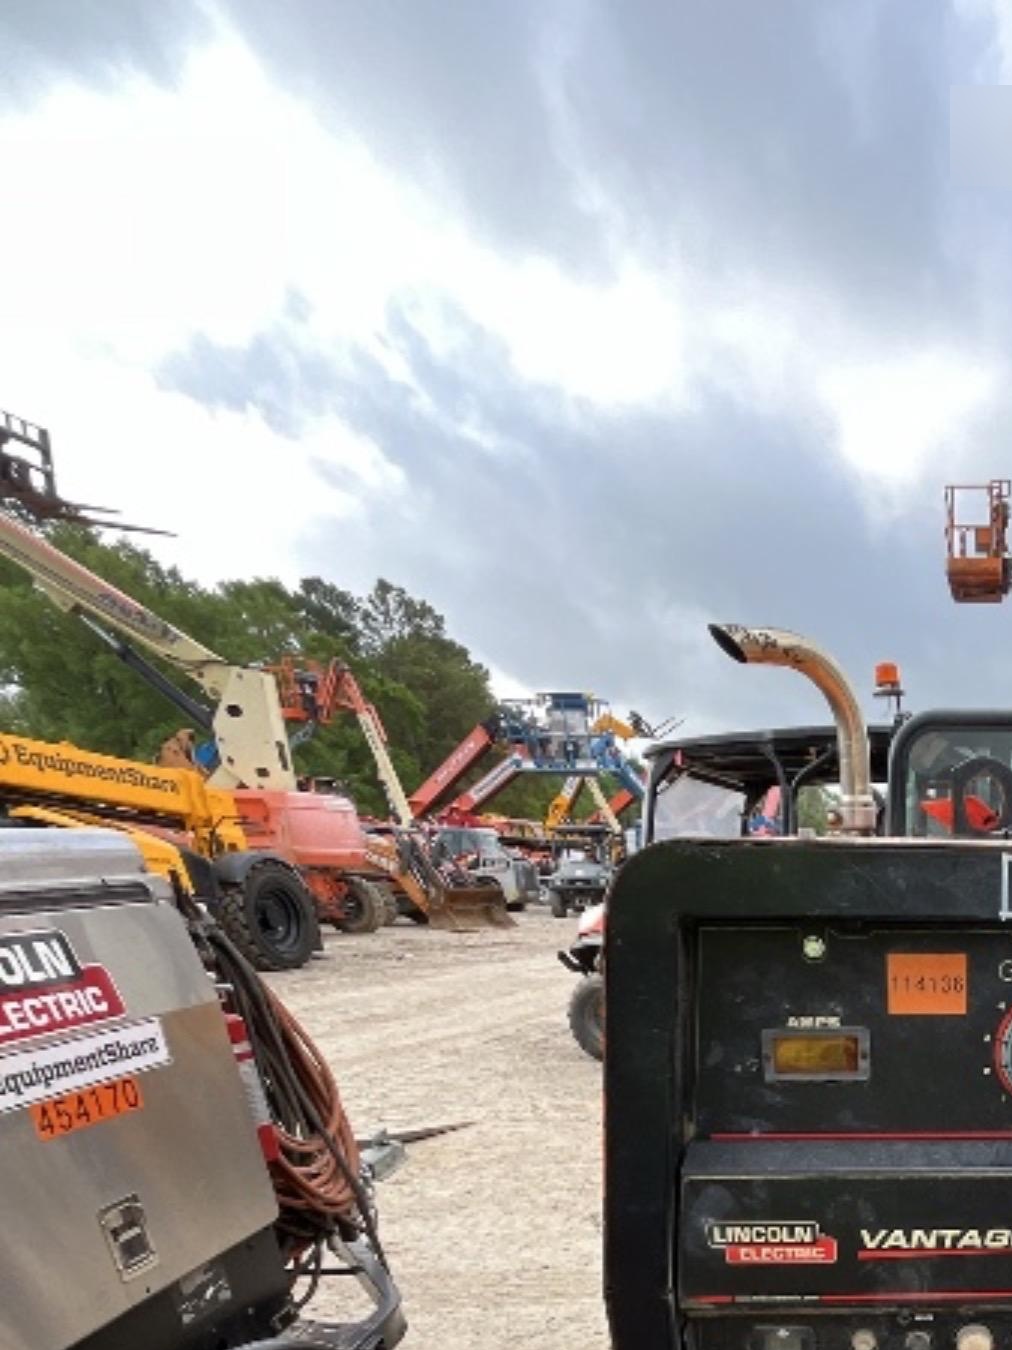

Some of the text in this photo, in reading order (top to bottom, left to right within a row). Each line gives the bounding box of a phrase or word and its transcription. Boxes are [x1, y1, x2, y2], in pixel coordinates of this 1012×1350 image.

[0, 985, 109, 1031] ECTRIC
[788, 1016, 841, 1028] AMPS
[0, 1037, 160, 1096] quipmentShare
[38, 1079, 139, 1134] 454170
[712, 1225, 816, 1243] LINCOLN
[739, 1246, 826, 1261] ELECTRIC
